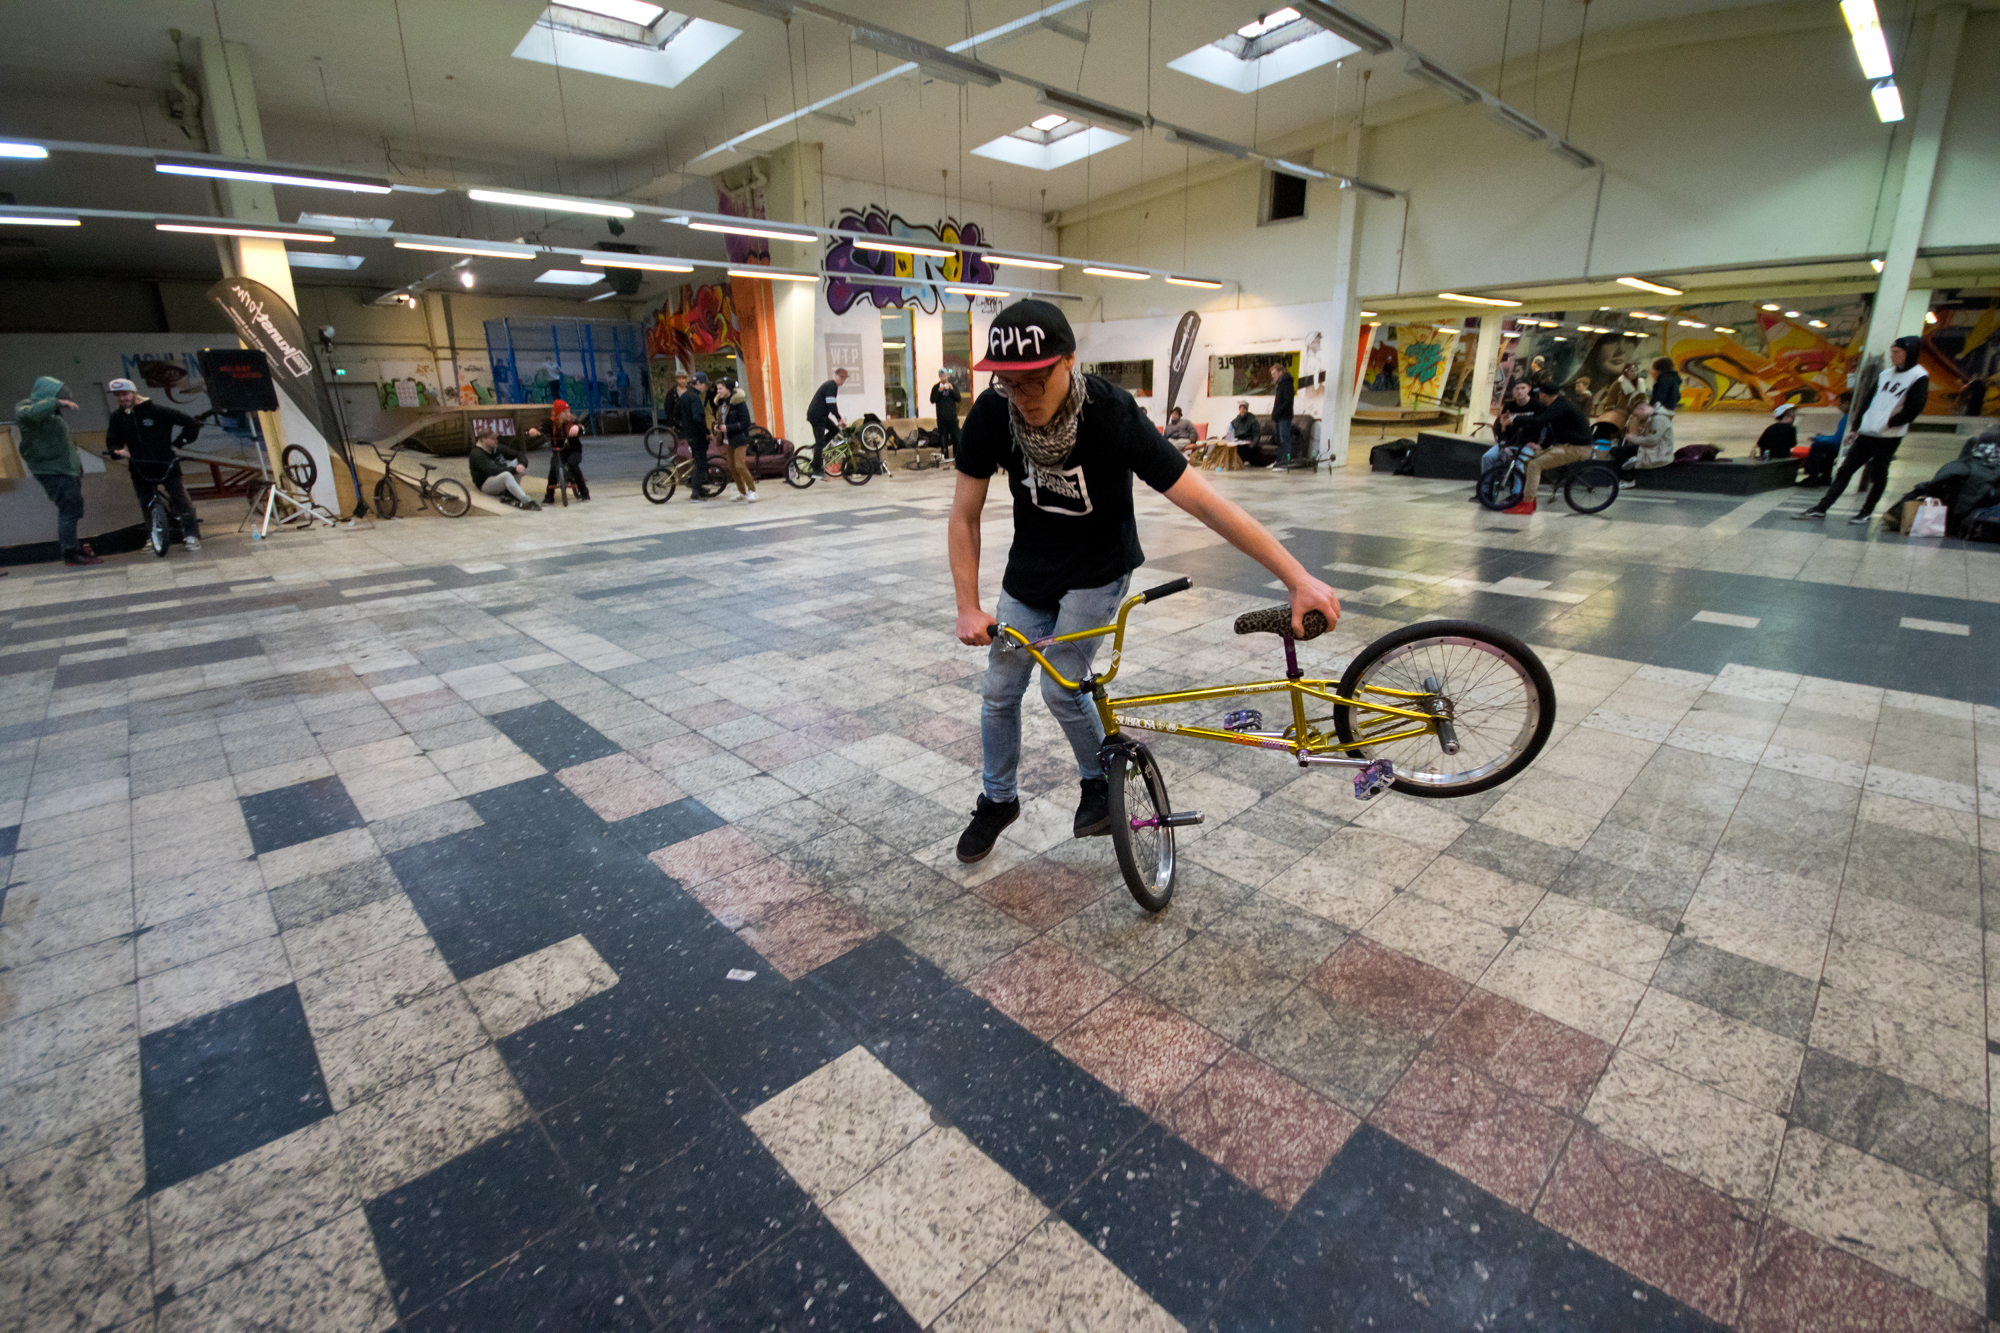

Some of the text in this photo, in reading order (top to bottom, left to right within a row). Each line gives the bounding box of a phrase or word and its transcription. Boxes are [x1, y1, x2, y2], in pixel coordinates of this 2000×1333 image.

[990, 325, 1046, 356] CULT
[1038, 477, 1081, 500] FORM
[1115, 715, 1156, 730] SUBROSA
